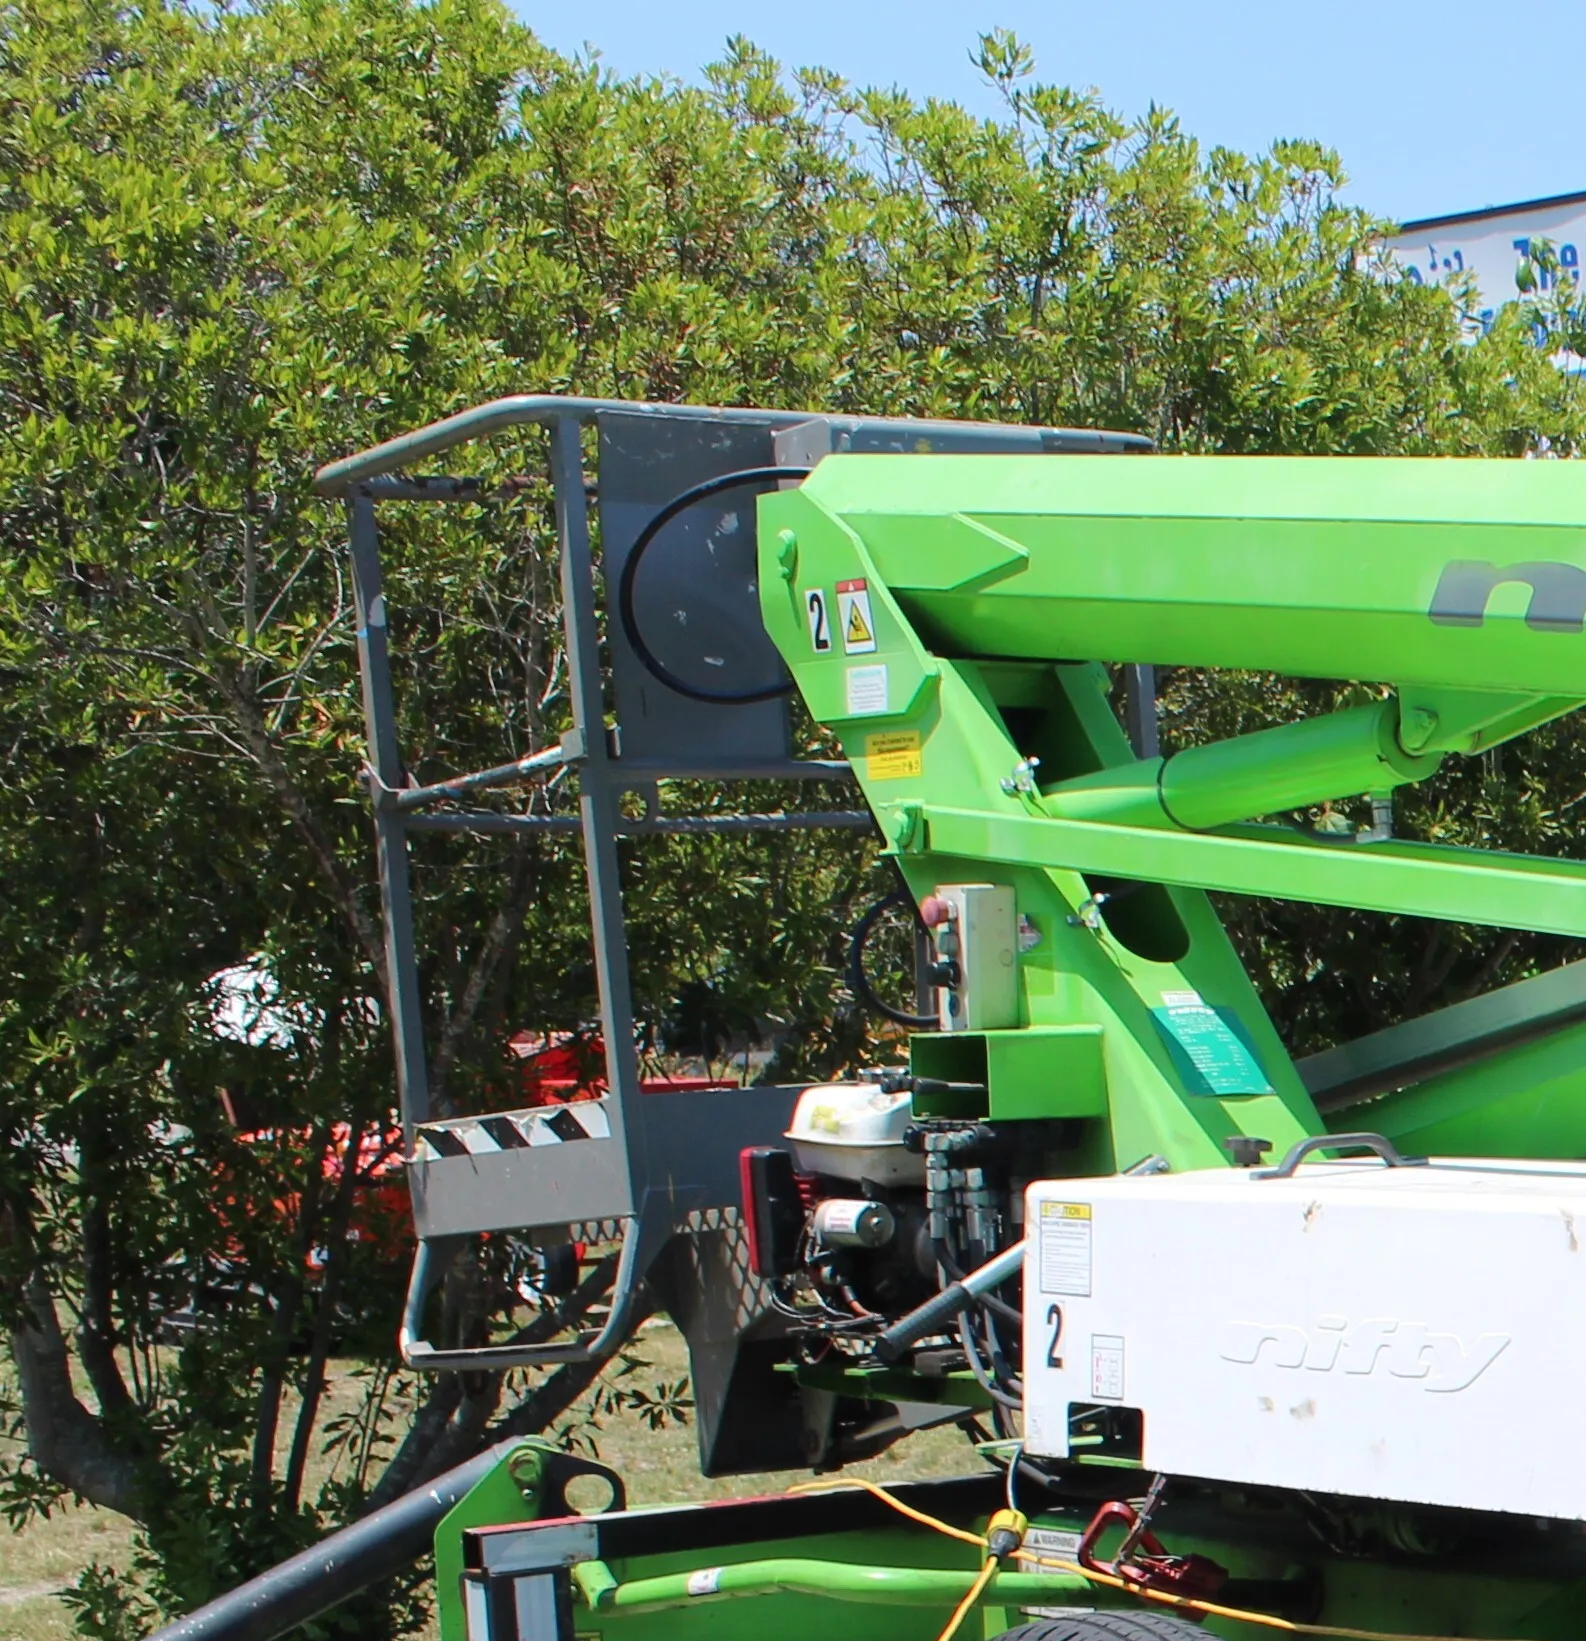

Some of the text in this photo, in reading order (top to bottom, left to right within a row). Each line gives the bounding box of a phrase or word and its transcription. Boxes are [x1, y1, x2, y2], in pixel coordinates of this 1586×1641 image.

[809, 592, 829, 650] 2
[1046, 1303, 1064, 1368] 2
[1218, 1314, 1512, 1393] nifty
